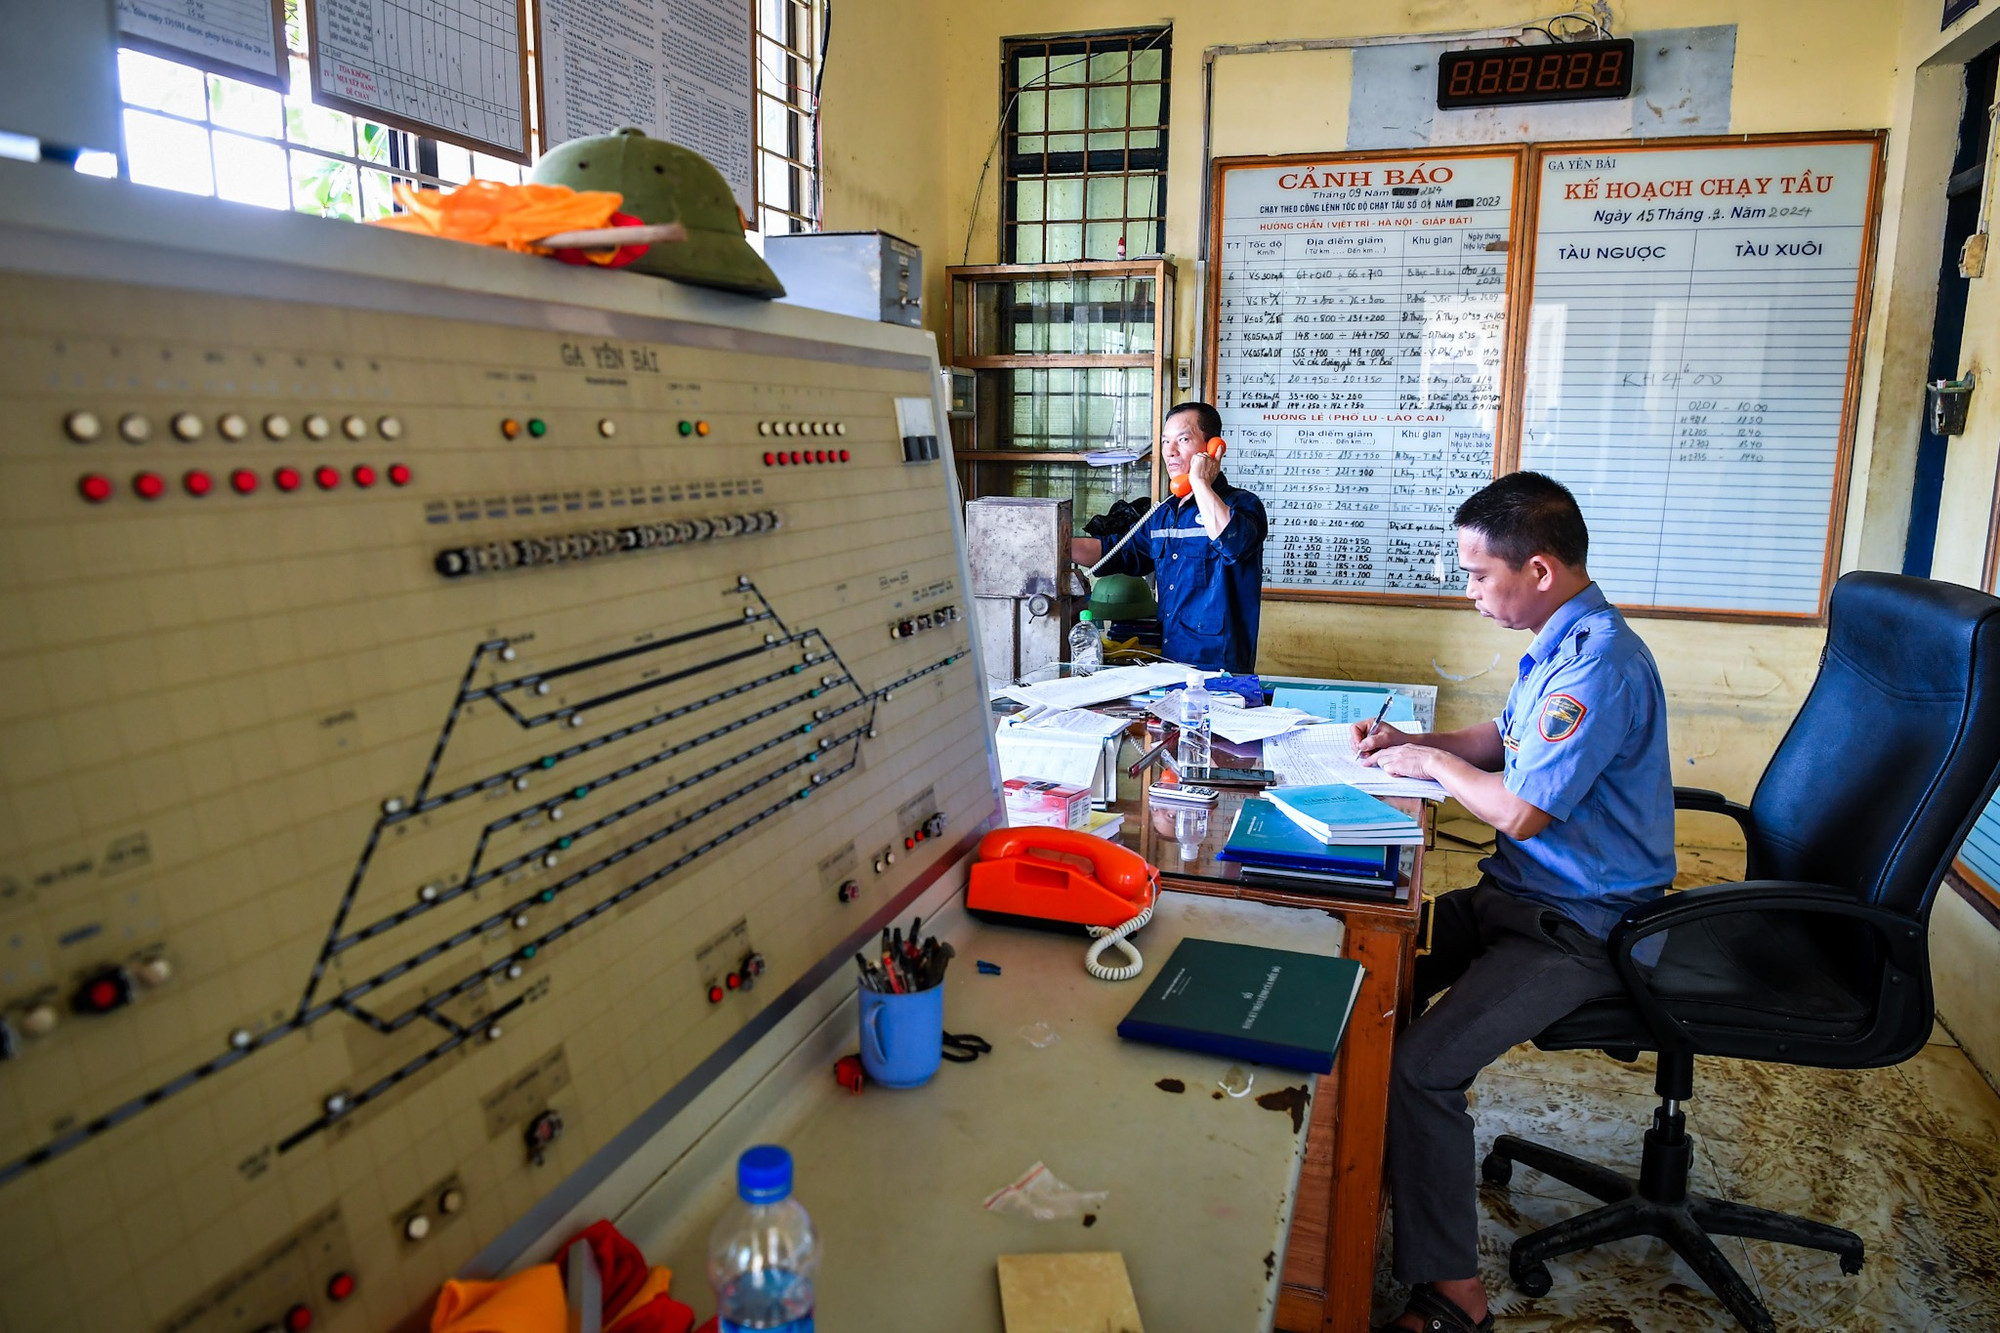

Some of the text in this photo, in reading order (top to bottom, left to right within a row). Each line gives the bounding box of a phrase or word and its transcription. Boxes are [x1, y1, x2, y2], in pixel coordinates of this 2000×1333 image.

[1548, 156, 1617, 171] GA YÊN BÁI
[1278, 162, 1454, 190] CẢNH BÁO
[1564, 168, 1834, 202] KẾ HOẠCH CHẠY TẦU
[1312, 191, 1347, 200] Tháng
[1260, 205, 1279, 215] CHẠY
[1280, 204, 1298, 213] THEO
[1300, 202, 1320, 213] CÔNG
[1321, 202, 1340, 214] LỆNH
[1357, 201, 1368, 212] ĐỘ
[1369, 201, 1389, 212] CHẠY
[1476, 195, 1501, 207] 2023
[1593, 209, 1633, 225] Ngày
[1636, 208, 1656, 223] 15
[1657, 207, 1704, 223] Tháng
[1730, 205, 1766, 219] Năm
[1768, 206, 1813, 219] 2024
[1378, 218, 1392, 227] HÀ
[1395, 217, 1412, 227] NỘI
[1422, 217, 1446, 226] GIÁP
[1247, 240, 1266, 249] Tốc
[1307, 238, 1324, 246] Địa
[1412, 235, 1453, 246] Khu gian
[1558, 243, 1667, 262] TÀU NGƯỢC
[1735, 240, 1823, 257] TÀU XUÔI
[560, 341, 661, 373] GA YÊN BÁI
[1263, 412, 1307, 421] HƯỚNG
[1241, 429, 1258, 437] Tốc
[1298, 429, 1315, 438] Địa
[1401, 429, 1442, 440] Khu gian
[1454, 431, 1471, 440] Ngày
